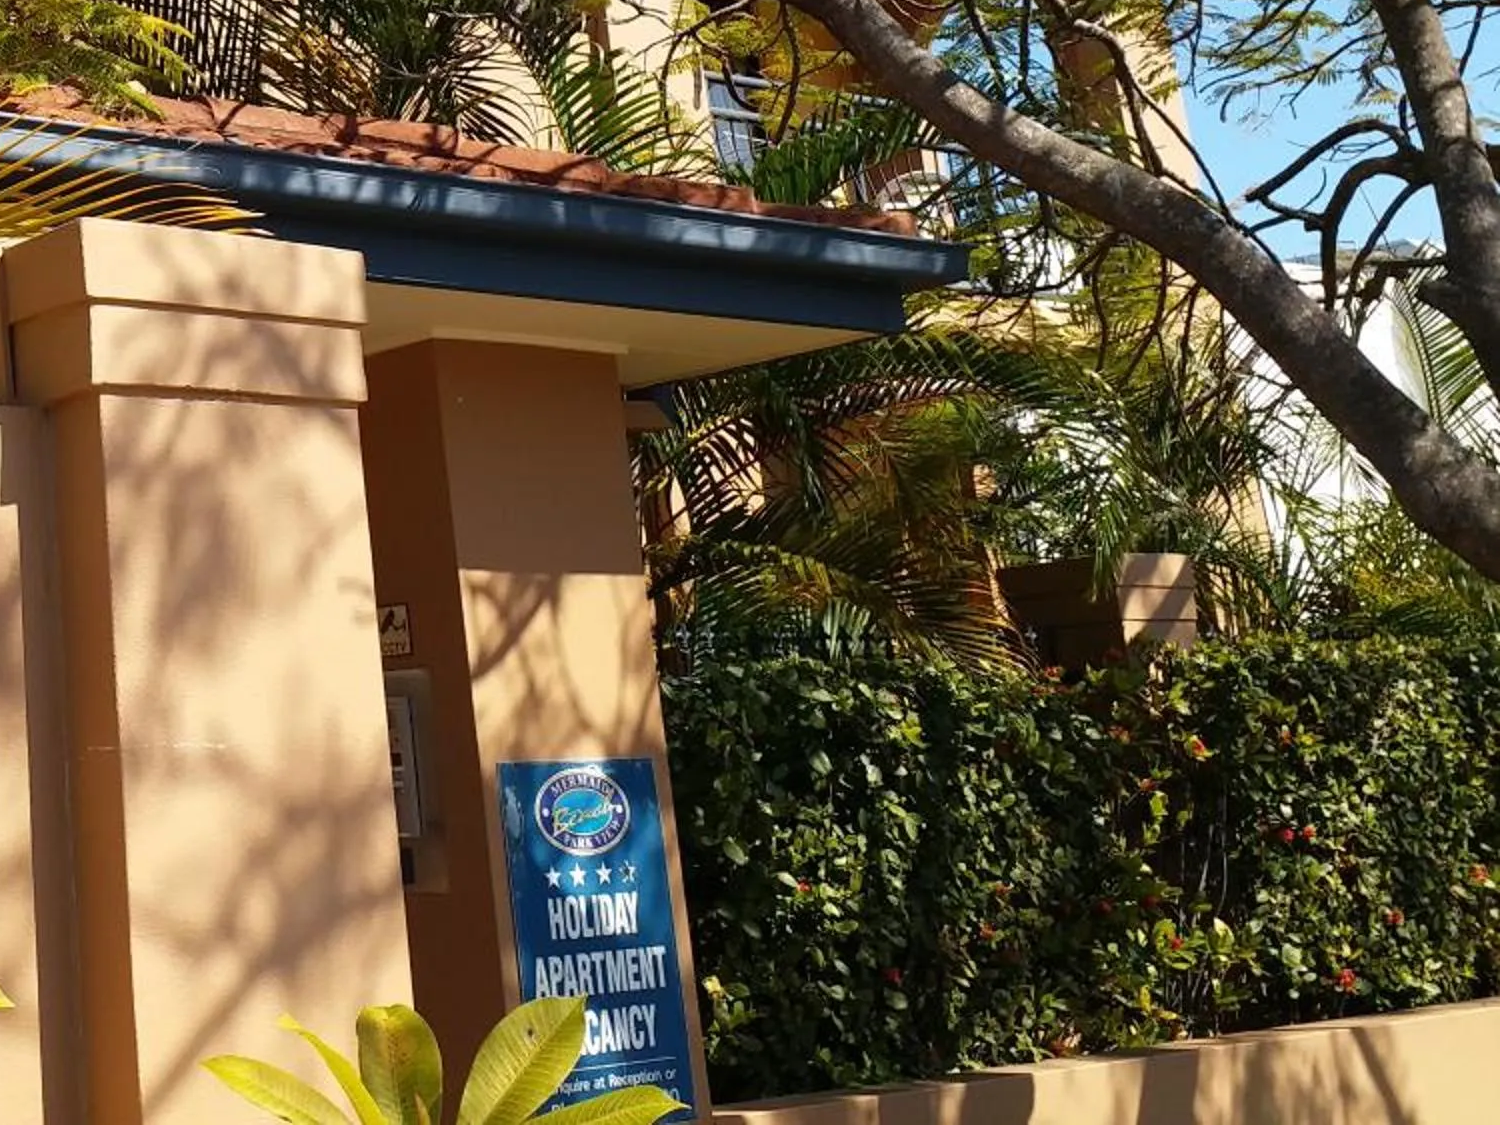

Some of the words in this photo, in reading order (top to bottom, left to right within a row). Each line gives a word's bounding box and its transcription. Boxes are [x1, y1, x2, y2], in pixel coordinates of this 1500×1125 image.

[547, 891, 638, 940] HOLIDAY
[535, 945, 666, 999] APARTMENT
[580, 1004, 656, 1055] CANCY
[593, 1076, 606, 1090] at
[608, 1070, 663, 1088] Reception
[665, 1068, 677, 1080] or
